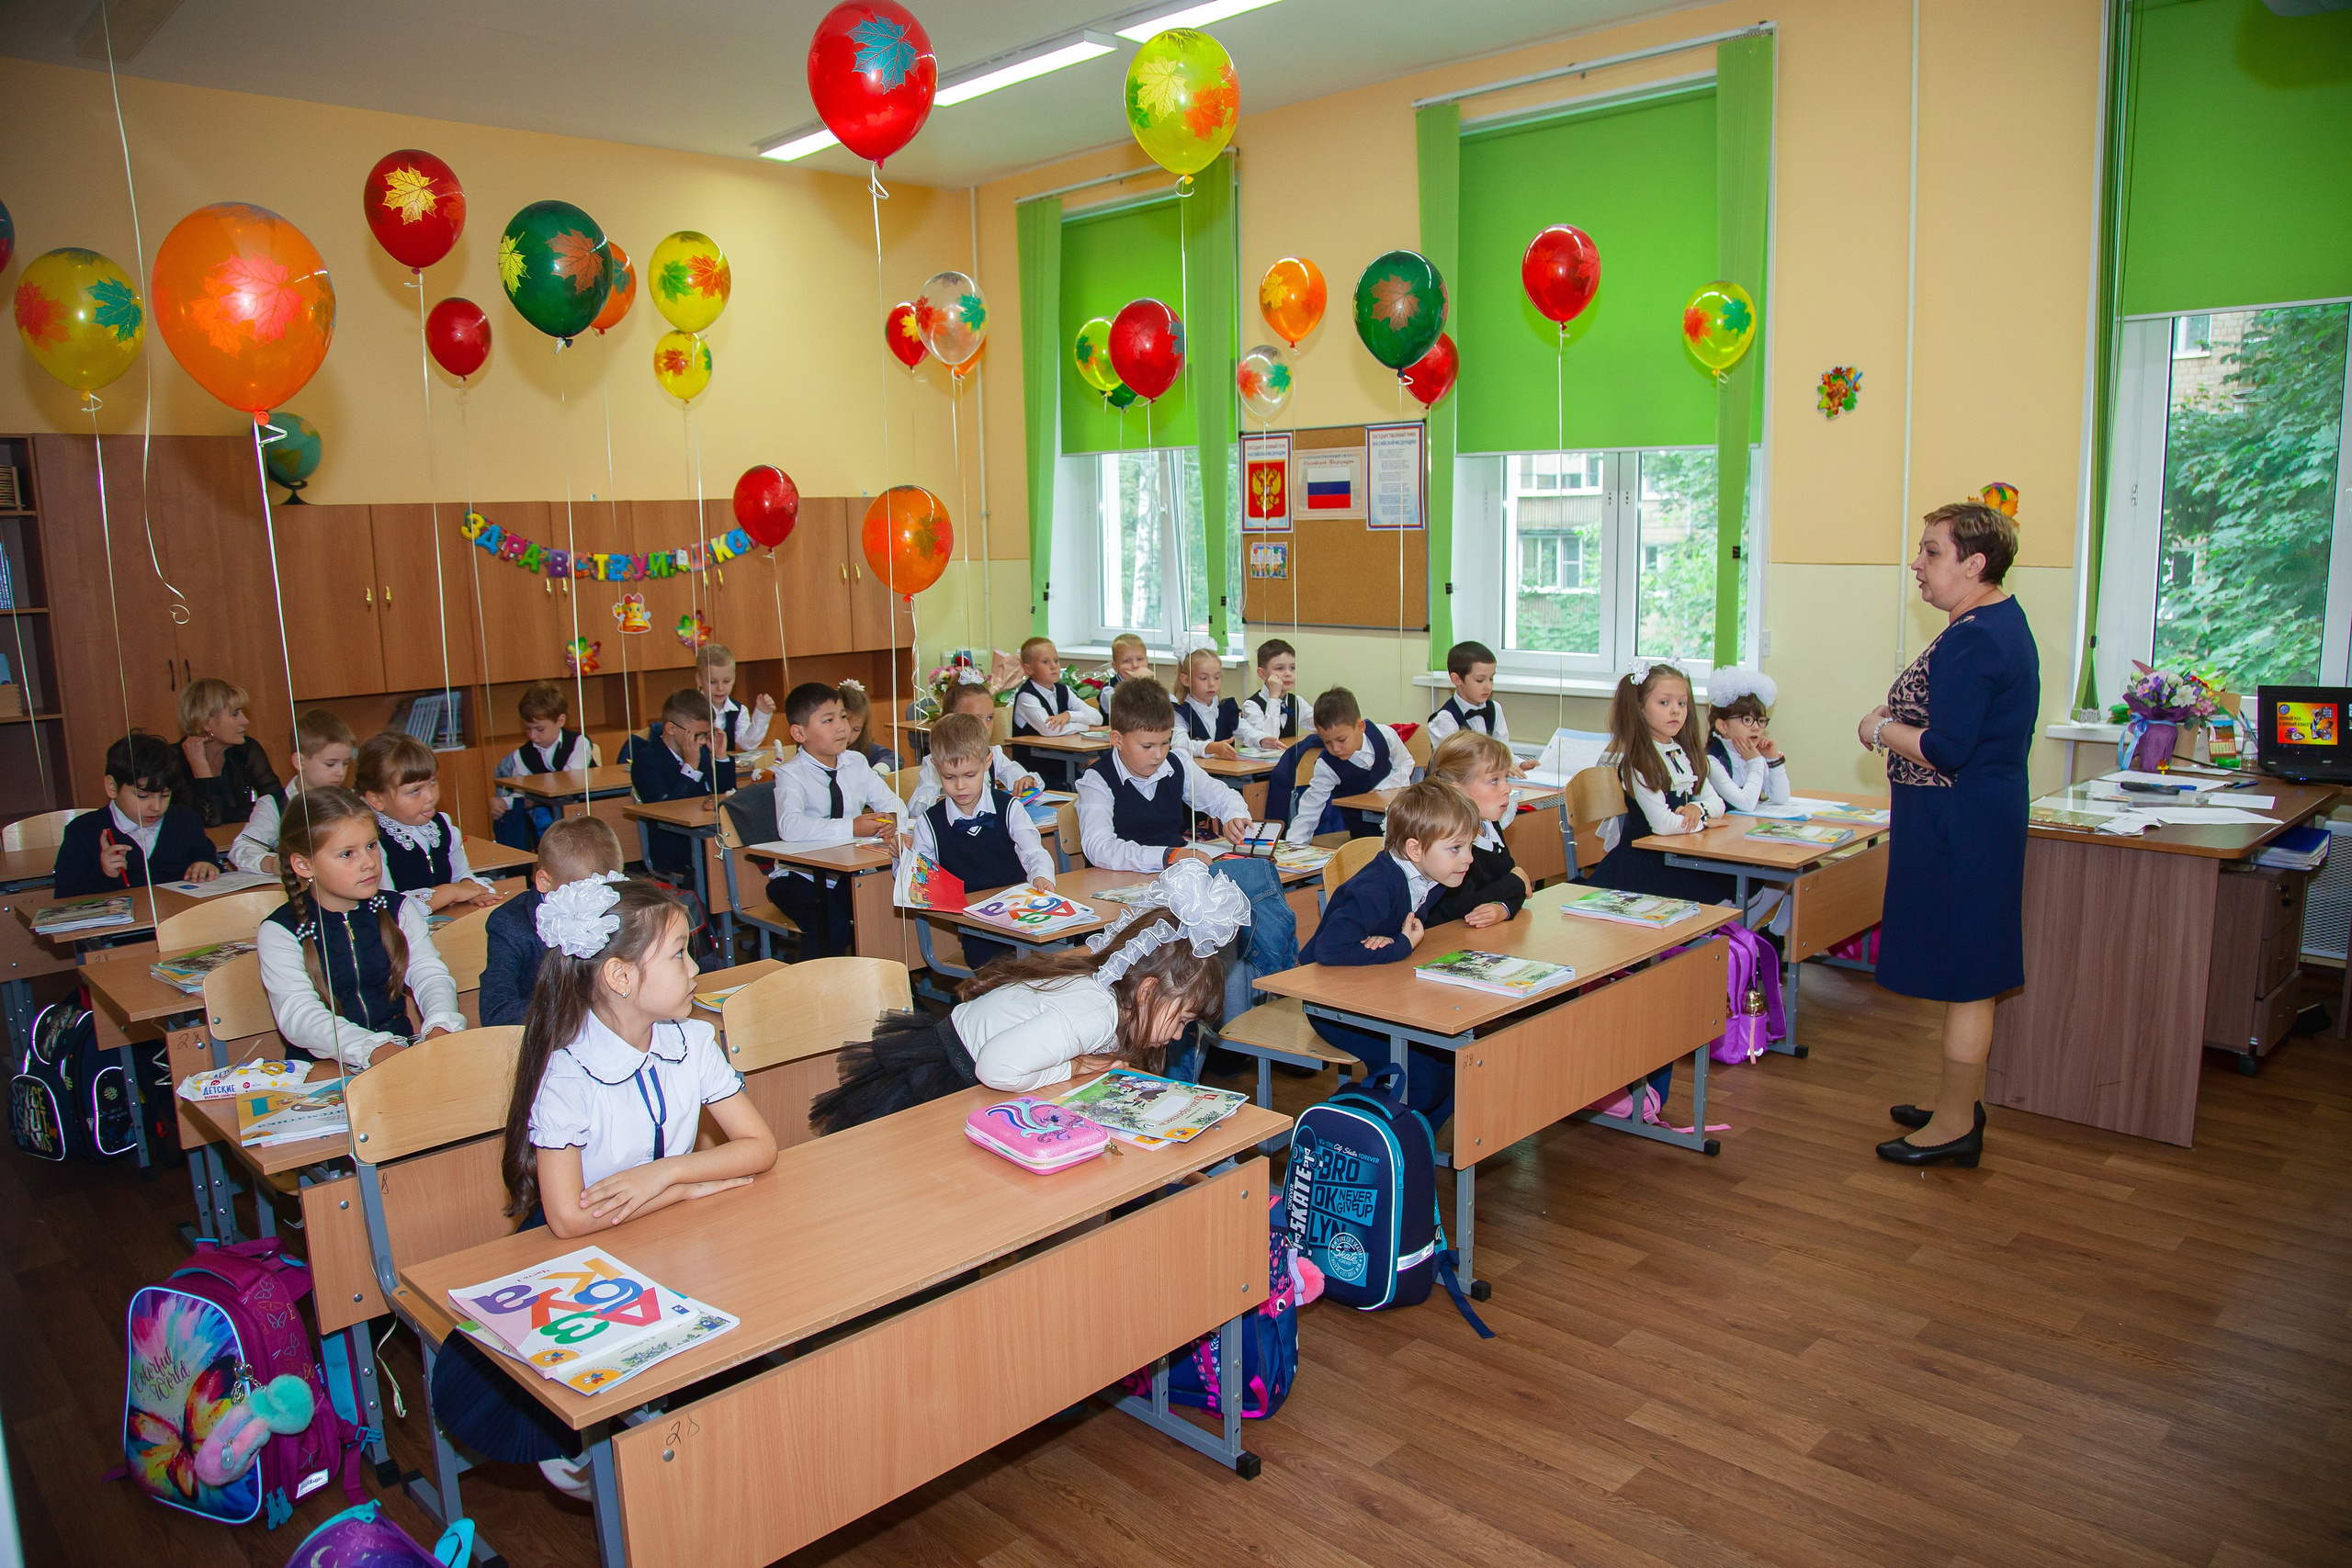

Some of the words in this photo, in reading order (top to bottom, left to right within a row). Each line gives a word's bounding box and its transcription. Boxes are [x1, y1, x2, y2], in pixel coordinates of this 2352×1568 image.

[203, 1085, 236, 1096] ДЕТСКИЕ
[1317, 1147, 1361, 1183] BRO
[1358, 1153, 1380, 1164] FOREVER
[1290, 1165, 1312, 1235] SKATE
[1314, 1186, 1340, 1213] OK
[1339, 1190, 1373, 1203] NEVER
[1336, 1200, 1359, 1214] GIVE
[1357, 1202, 1374, 1218] UP
[1332, 1246, 1358, 1264] Skate
[132, 1346, 175, 1393] Colorful
[149, 1359, 190, 1402] World
